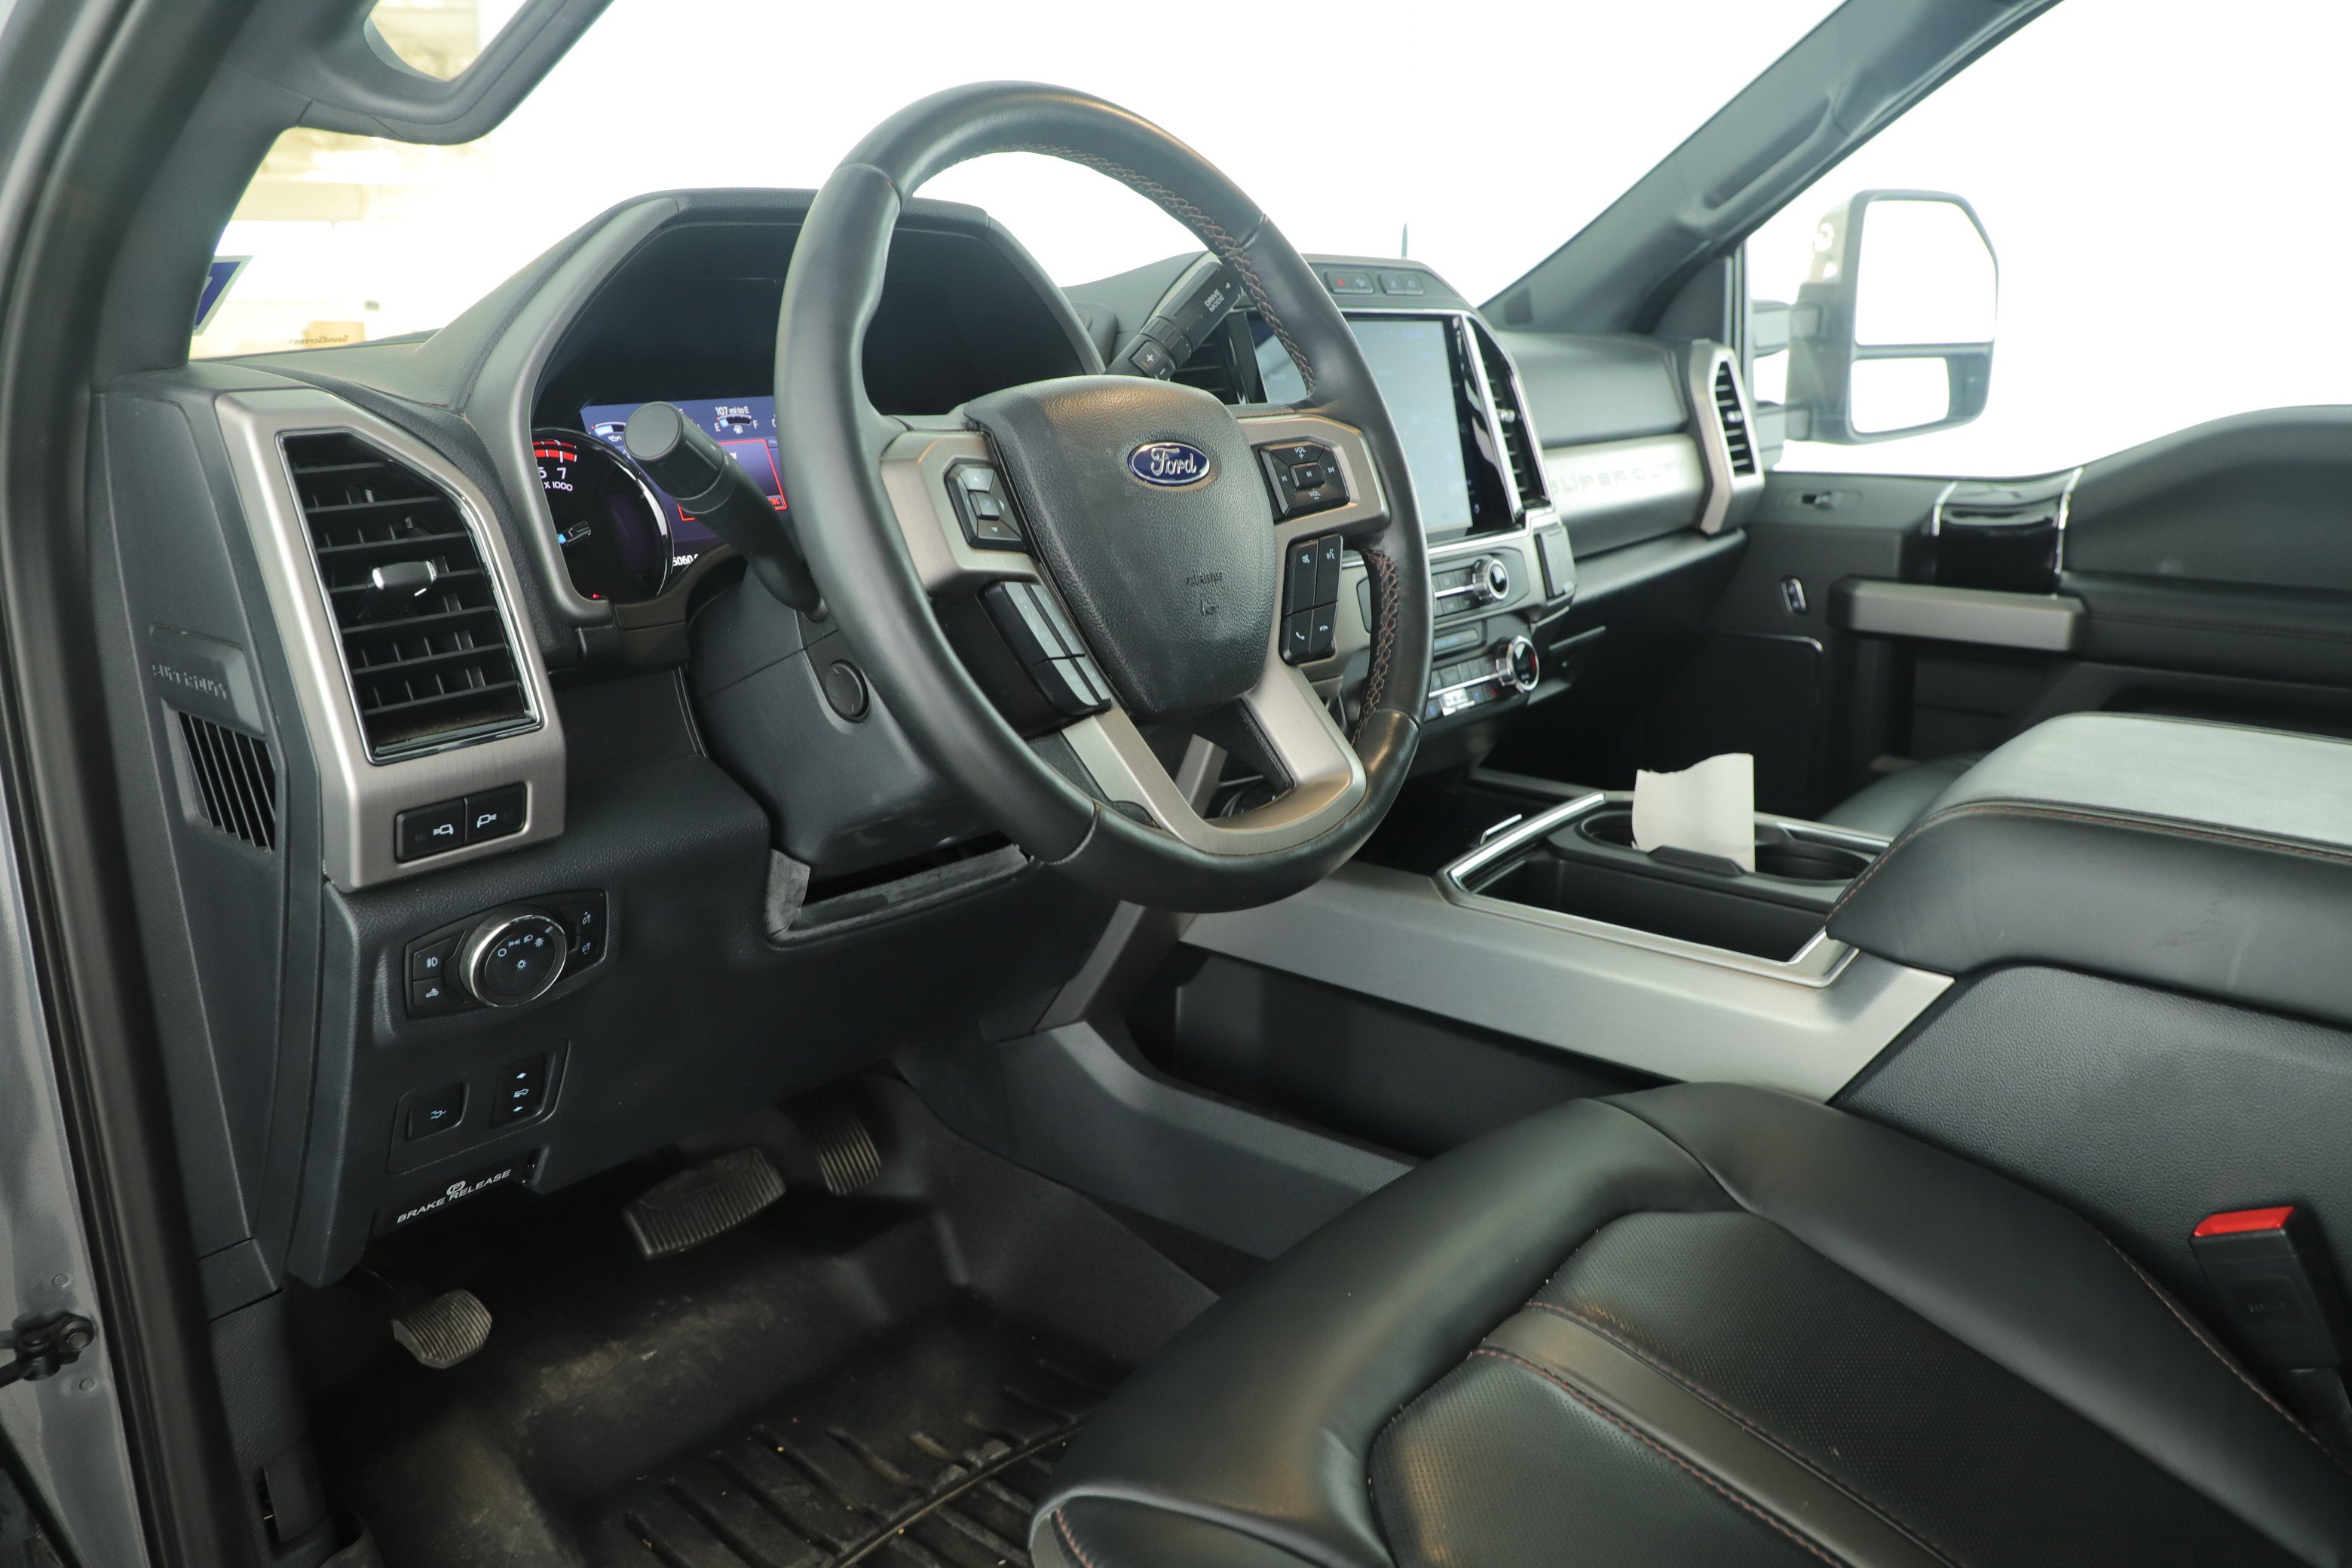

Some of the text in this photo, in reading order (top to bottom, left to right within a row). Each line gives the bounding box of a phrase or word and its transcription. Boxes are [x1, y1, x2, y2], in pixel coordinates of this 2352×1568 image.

[1205, 288, 1221, 307] DRIVE
[1208, 294, 1225, 313] MODE
[715, 406, 728, 416] 107
[743, 406, 750, 414] E
[714, 422, 721, 432] E
[752, 419, 758, 429] F
[1150, 447, 1197, 476] Ford
[556, 467, 567, 479] 7
[552, 481, 573, 492] 1000
[672, 553, 699, 567] 5060
[1187, 571, 1223, 586] AIRBAG
[397, 1169, 512, 1224] BRAKE RELEASE
